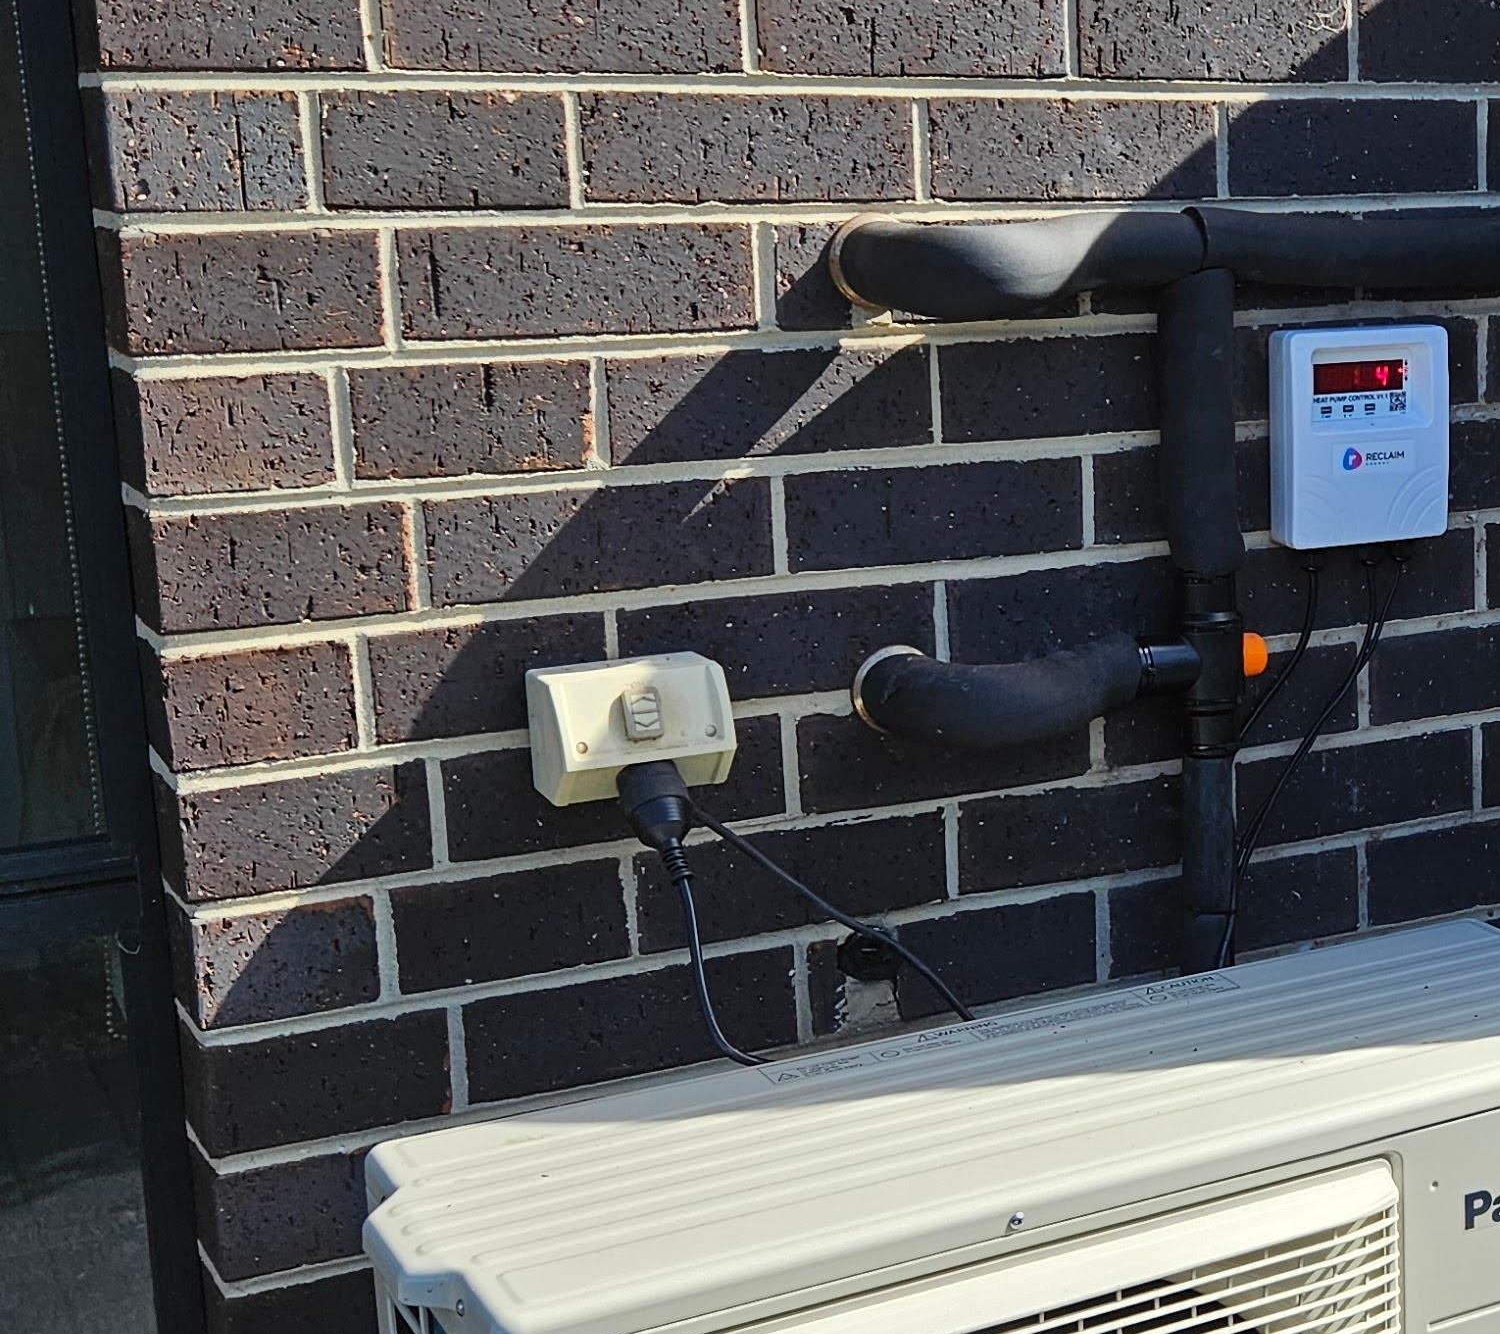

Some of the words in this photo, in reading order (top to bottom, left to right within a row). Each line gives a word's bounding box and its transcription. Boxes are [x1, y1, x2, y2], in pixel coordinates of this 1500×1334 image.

[1376, 366, 1389, 386] 4
[1313, 395, 1328, 404] HEAT
[1329, 394, 1348, 403] PUMP
[1348, 392, 1375, 402] CONTROL
[1365, 450, 1405, 462] RECLAIM
[1161, 975, 1215, 990] CAUTION
[935, 1020, 998, 1038] WARNING
